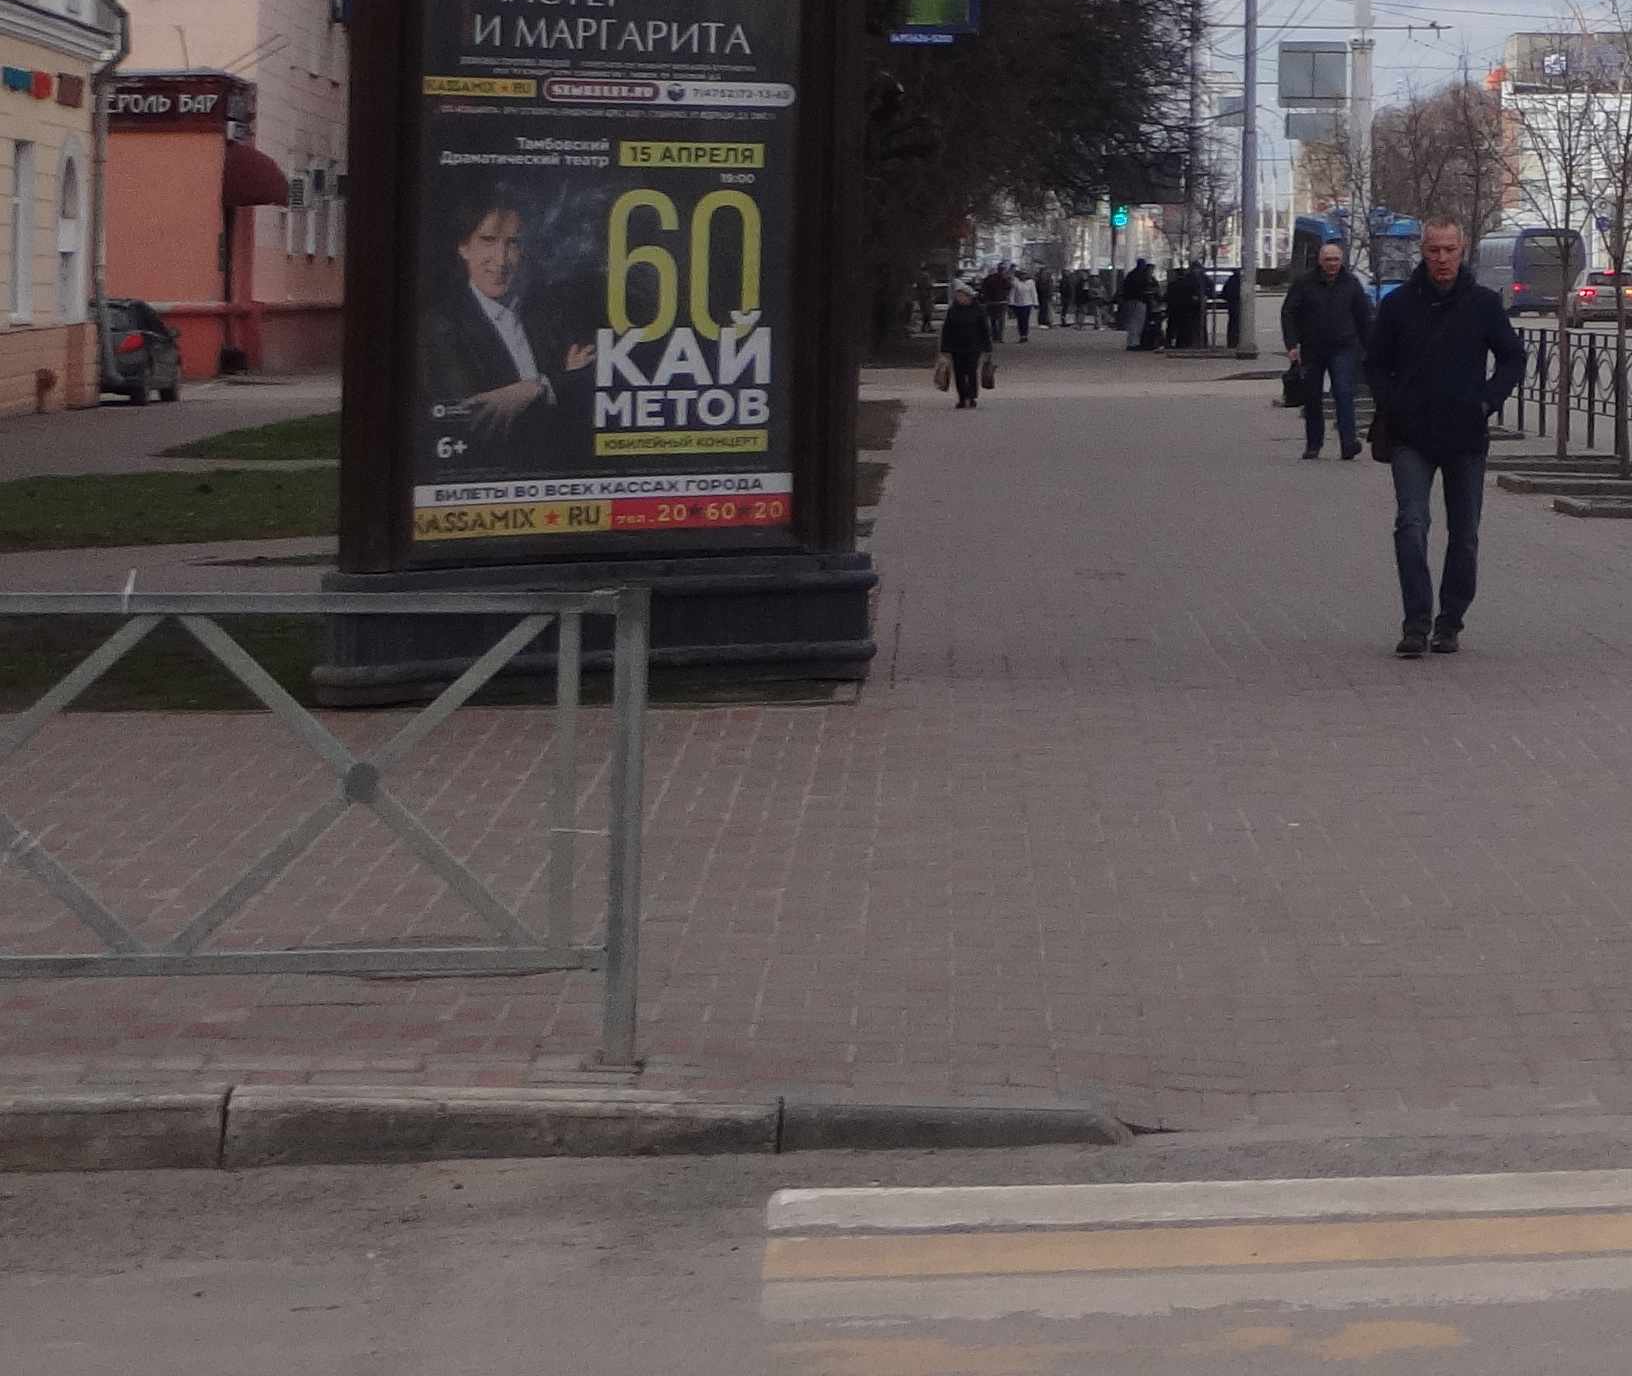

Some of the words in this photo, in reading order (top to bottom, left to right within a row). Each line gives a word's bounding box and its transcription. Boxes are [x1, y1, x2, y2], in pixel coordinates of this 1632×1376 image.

[473, 13, 502, 47] И
[513, 15, 753, 55] МАРГАРИТА
[178, 93, 219, 113] БАР
[516, 137, 610, 152] Тамбовский
[630, 145, 650, 163] 15
[660, 145, 755, 163] АПРЕЛЯ
[439, 150, 562, 167] Драматический
[563, 154, 610, 168] театр
[608, 189, 762, 343] 60
[595, 309, 772, 387] КАЙ
[594, 388, 770, 428] МЕТОВ
[436, 436, 468, 459] 6+
[604, 435, 693, 450] ЮБИЛЕЙНЫЙ
[696, 436, 760, 448] КОНЦЕРТ
[434, 487, 509, 503] БИЛЕТЫ
[514, 484, 540, 498] ВО
[545, 482, 596, 497] ВСЕХ
[599, 480, 680, 494] КАССАХ
[685, 478, 764, 492] ГОРОДА
[568, 505, 601, 526] RU
